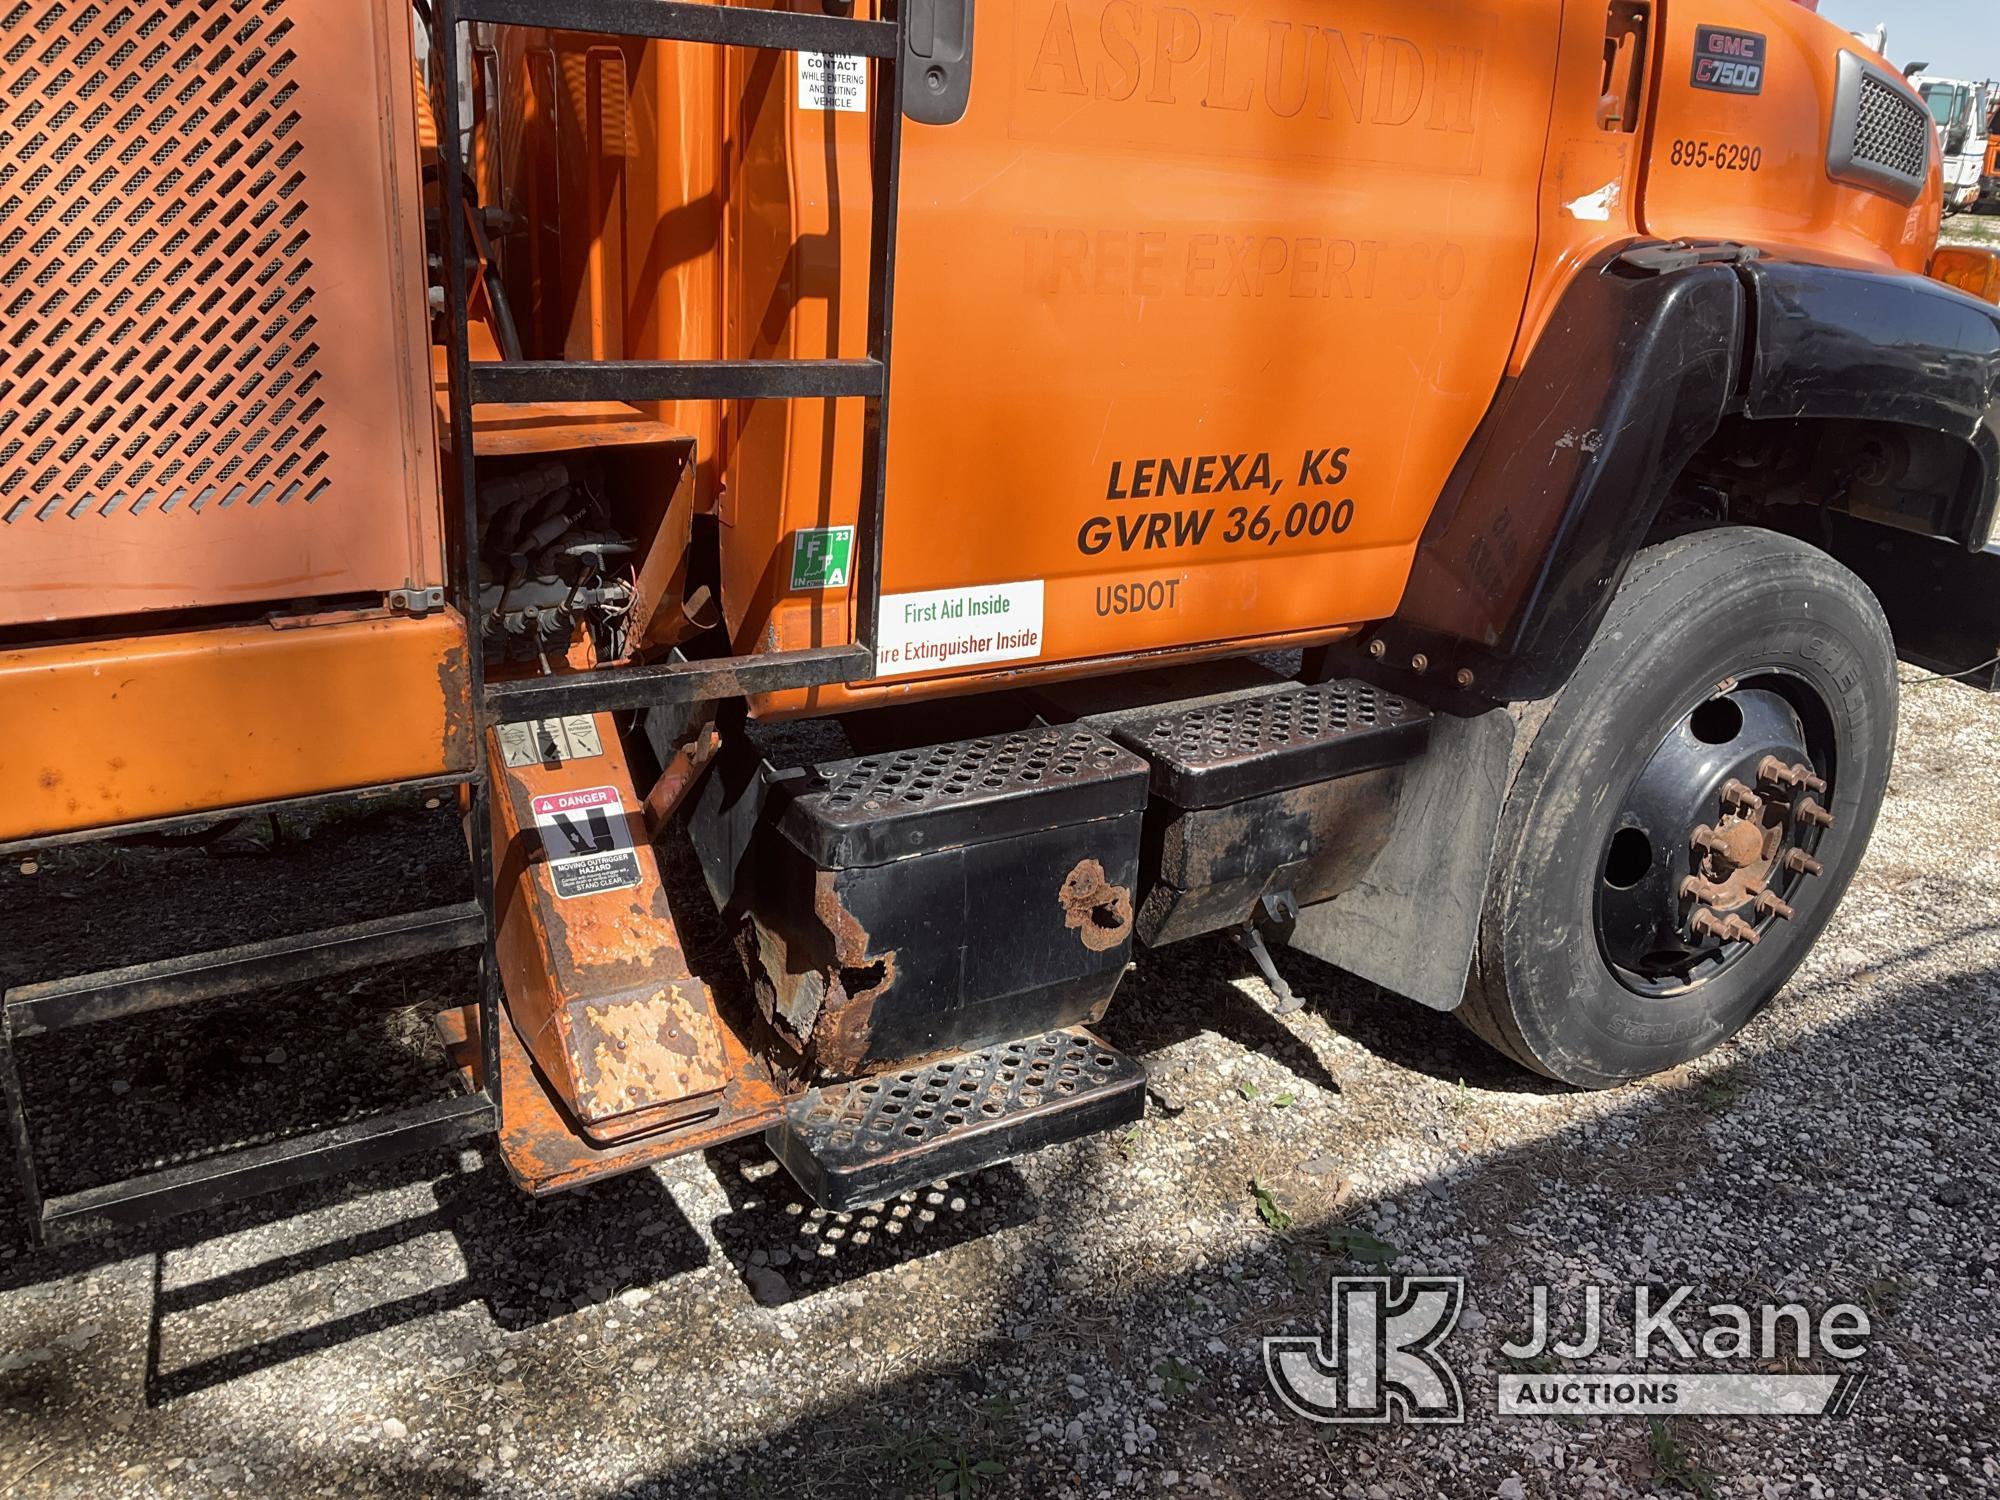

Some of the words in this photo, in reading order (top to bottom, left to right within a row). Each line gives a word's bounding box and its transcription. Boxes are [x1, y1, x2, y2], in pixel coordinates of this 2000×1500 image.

[1708, 34, 1754, 57] GMC
[808, 59, 858, 71] CONTACT
[1024, 0, 1484, 134] ASPLUNDH
[1696, 59, 1760, 88] C7500
[801, 71, 825, 82] WHILE
[827, 73, 864, 85] ENTERING
[809, 84, 825, 93] AND
[827, 85, 857, 96] EXITING
[814, 97, 852, 108] VEHICLE
[1670, 140, 1762, 171] 895-6290
[1013, 226, 1167, 297] TREE
[1184, 233, 1388, 299] EXPERT
[1106, 452, 1283, 500] LENEXA,
[1297, 447, 1350, 486] KS
[835, 531, 849, 541] 23
[1077, 508, 1215, 555] GVRW
[1222, 499, 1354, 546] 36,000
[794, 578, 806, 586] IN
[1096, 579, 1180, 616] USDOT
[904, 602, 937, 623] First
[941, 598, 963, 619] Aid
[968, 594, 1010, 616] Inside
[877, 645, 899, 663] ire
[904, 635, 993, 661] Extinguisher
[997, 628, 1037, 650] Inside
[559, 792, 608, 808] DANGER
[558, 861, 586, 871] MOVING
[587, 854, 629, 866] OUTRIGGER
[579, 864, 611, 875] HAZARD
[576, 882, 599, 891] STAND
[600, 877, 623, 886] CLEAR
